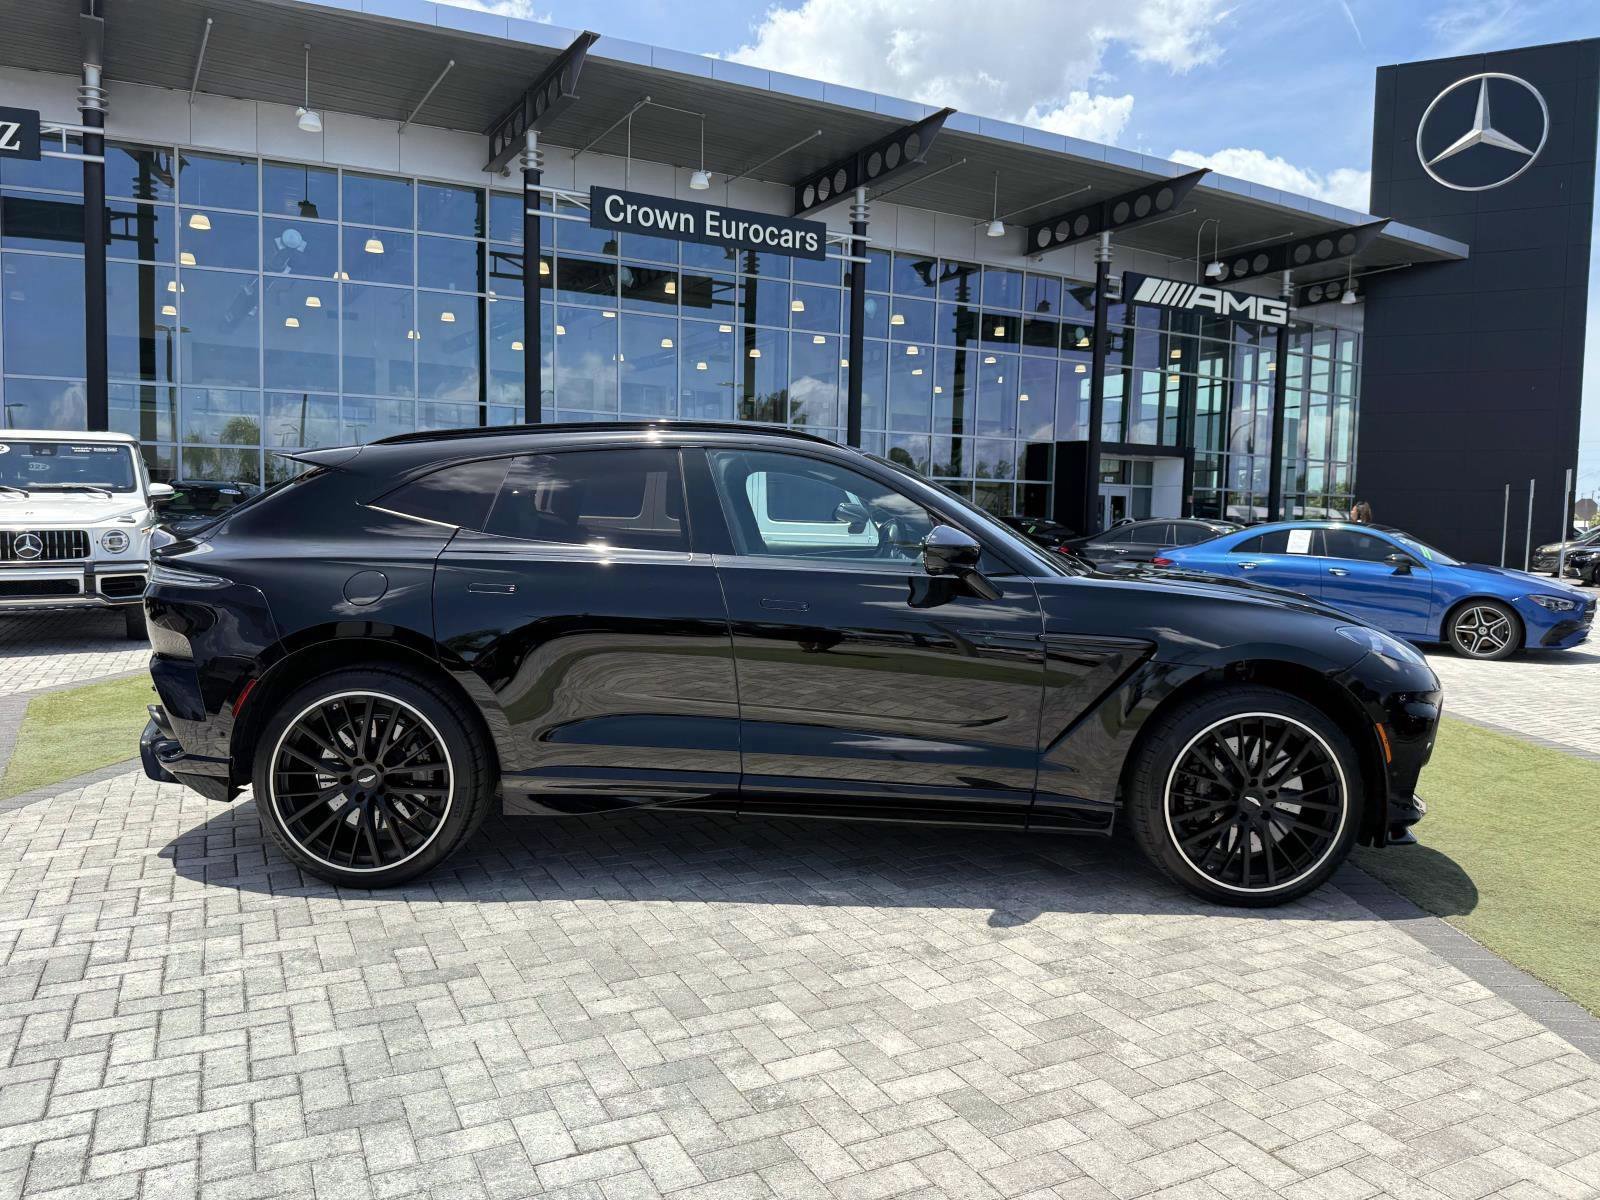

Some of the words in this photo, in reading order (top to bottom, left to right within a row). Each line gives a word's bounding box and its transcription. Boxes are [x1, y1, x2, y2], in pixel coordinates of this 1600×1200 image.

[604, 194, 695, 233] Crown
[705, 210, 818, 251] Eurocars
[1185, 286, 1287, 325] AMG
